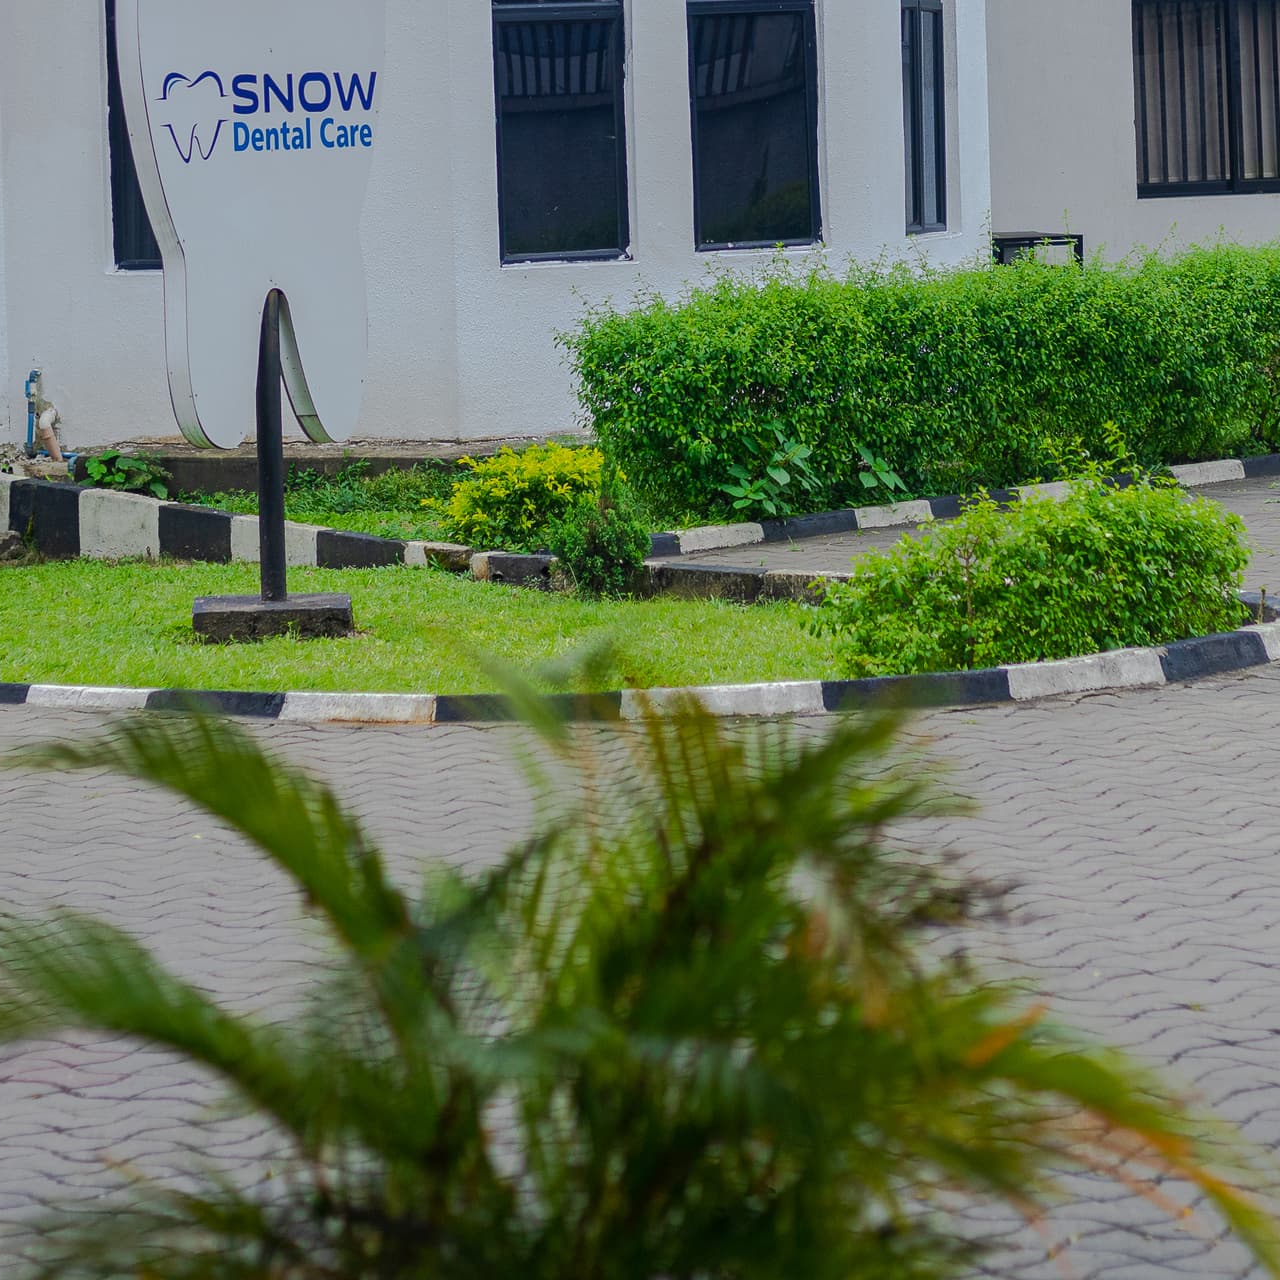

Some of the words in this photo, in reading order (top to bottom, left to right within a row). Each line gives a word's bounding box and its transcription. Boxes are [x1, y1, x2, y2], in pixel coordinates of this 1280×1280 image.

[232, 71, 377, 115] SNOW
[233, 117, 312, 152] Dental
[320, 117, 373, 149] Care
